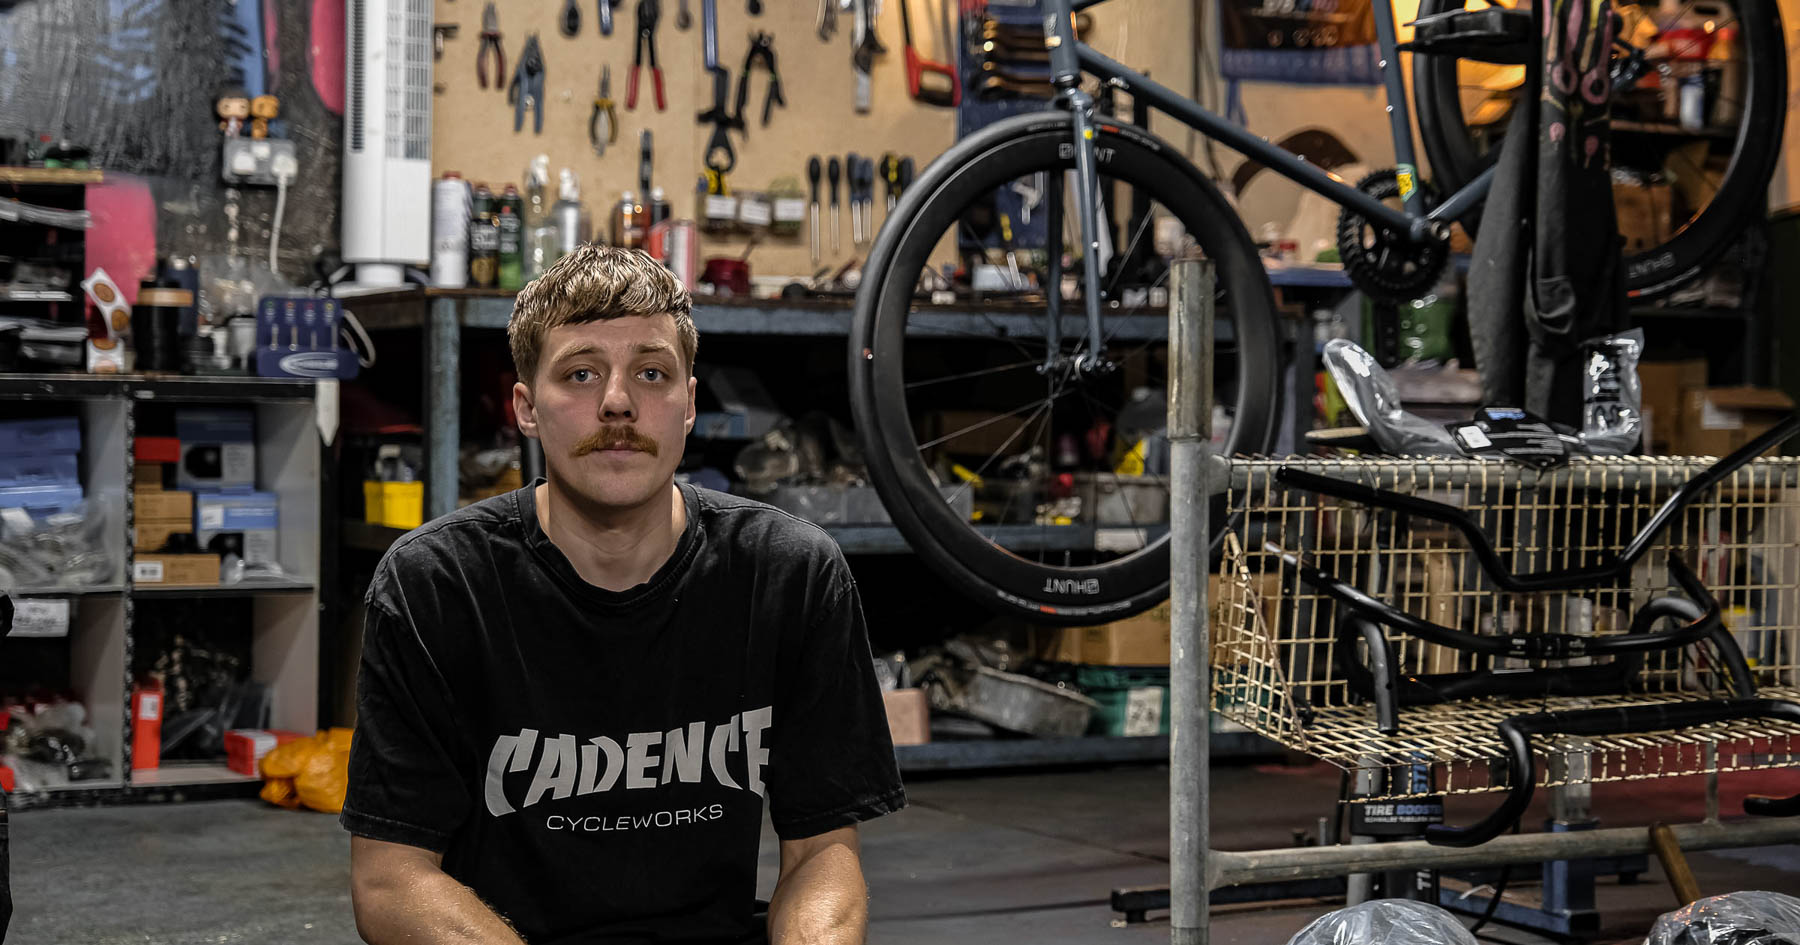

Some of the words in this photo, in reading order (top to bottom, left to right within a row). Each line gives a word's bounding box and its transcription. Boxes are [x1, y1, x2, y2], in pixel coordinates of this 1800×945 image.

[1045, 578, 1087, 594] HUNT
[485, 706, 773, 818] CADENCE
[546, 803, 723, 832] CYCLEWORKS
[1364, 804, 1395, 816] TIRE
[1396, 804, 1441, 815] BOOSTE
[1416, 869, 1432, 891] TI
